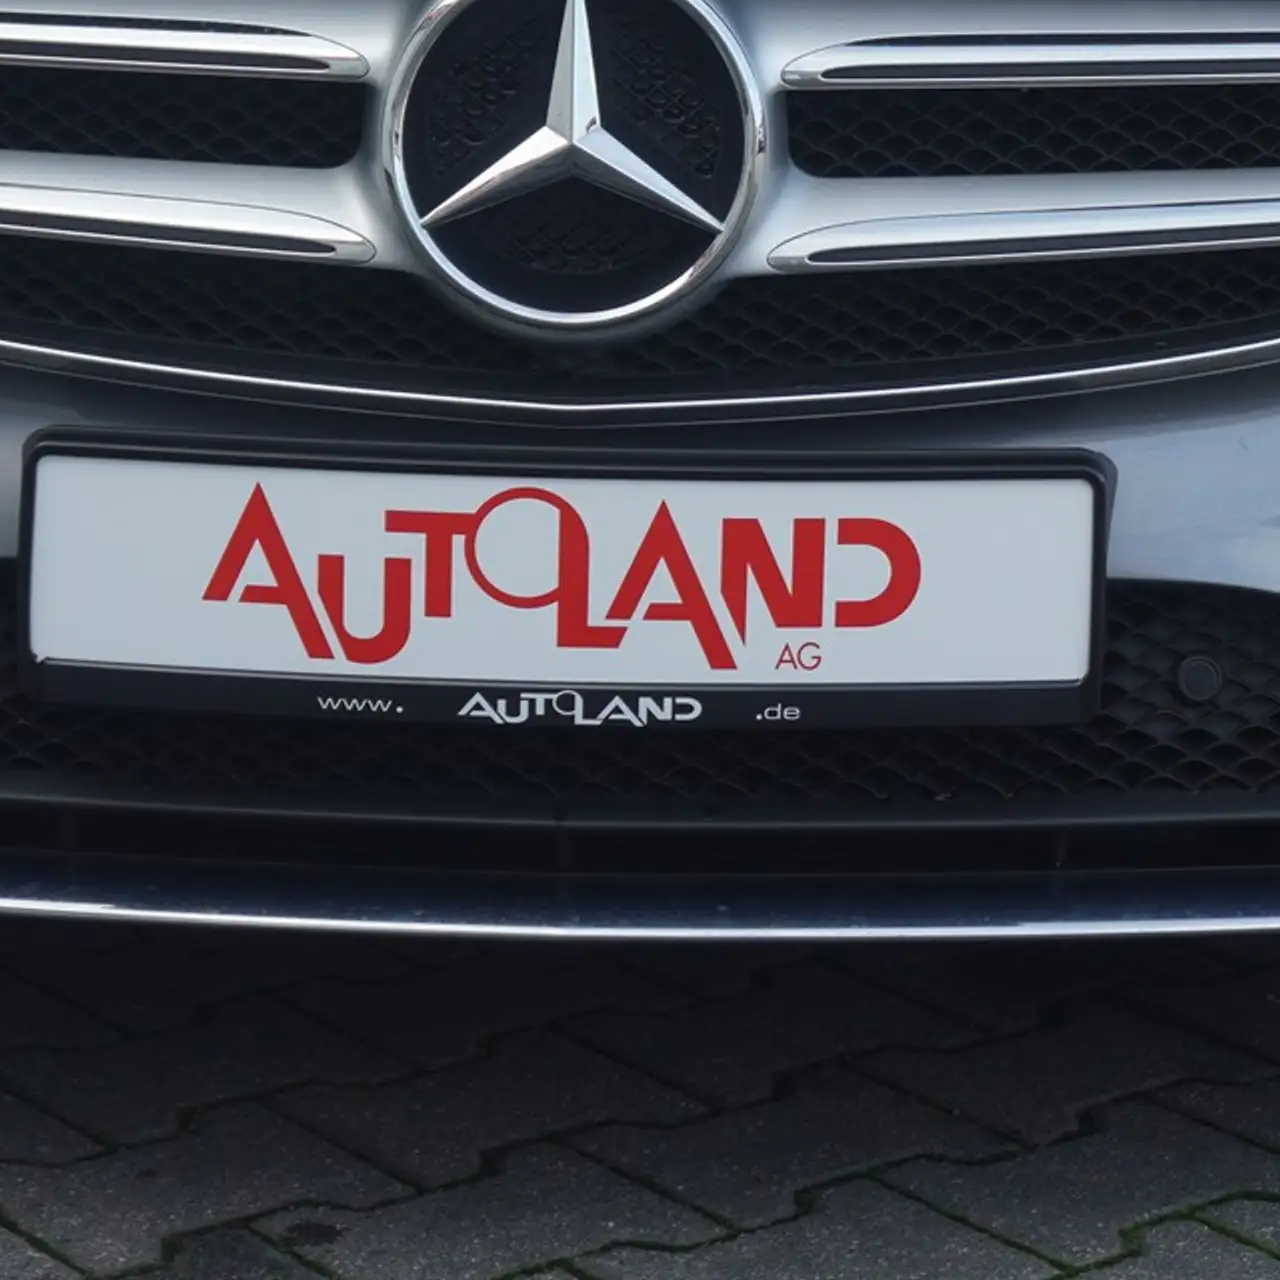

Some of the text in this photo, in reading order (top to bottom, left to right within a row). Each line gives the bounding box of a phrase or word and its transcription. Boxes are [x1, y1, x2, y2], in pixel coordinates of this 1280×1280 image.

[203, 482, 923, 670] AUTOLAND
[774, 642, 823, 671] AG
[457, 690, 703, 728] AUTOLAND
